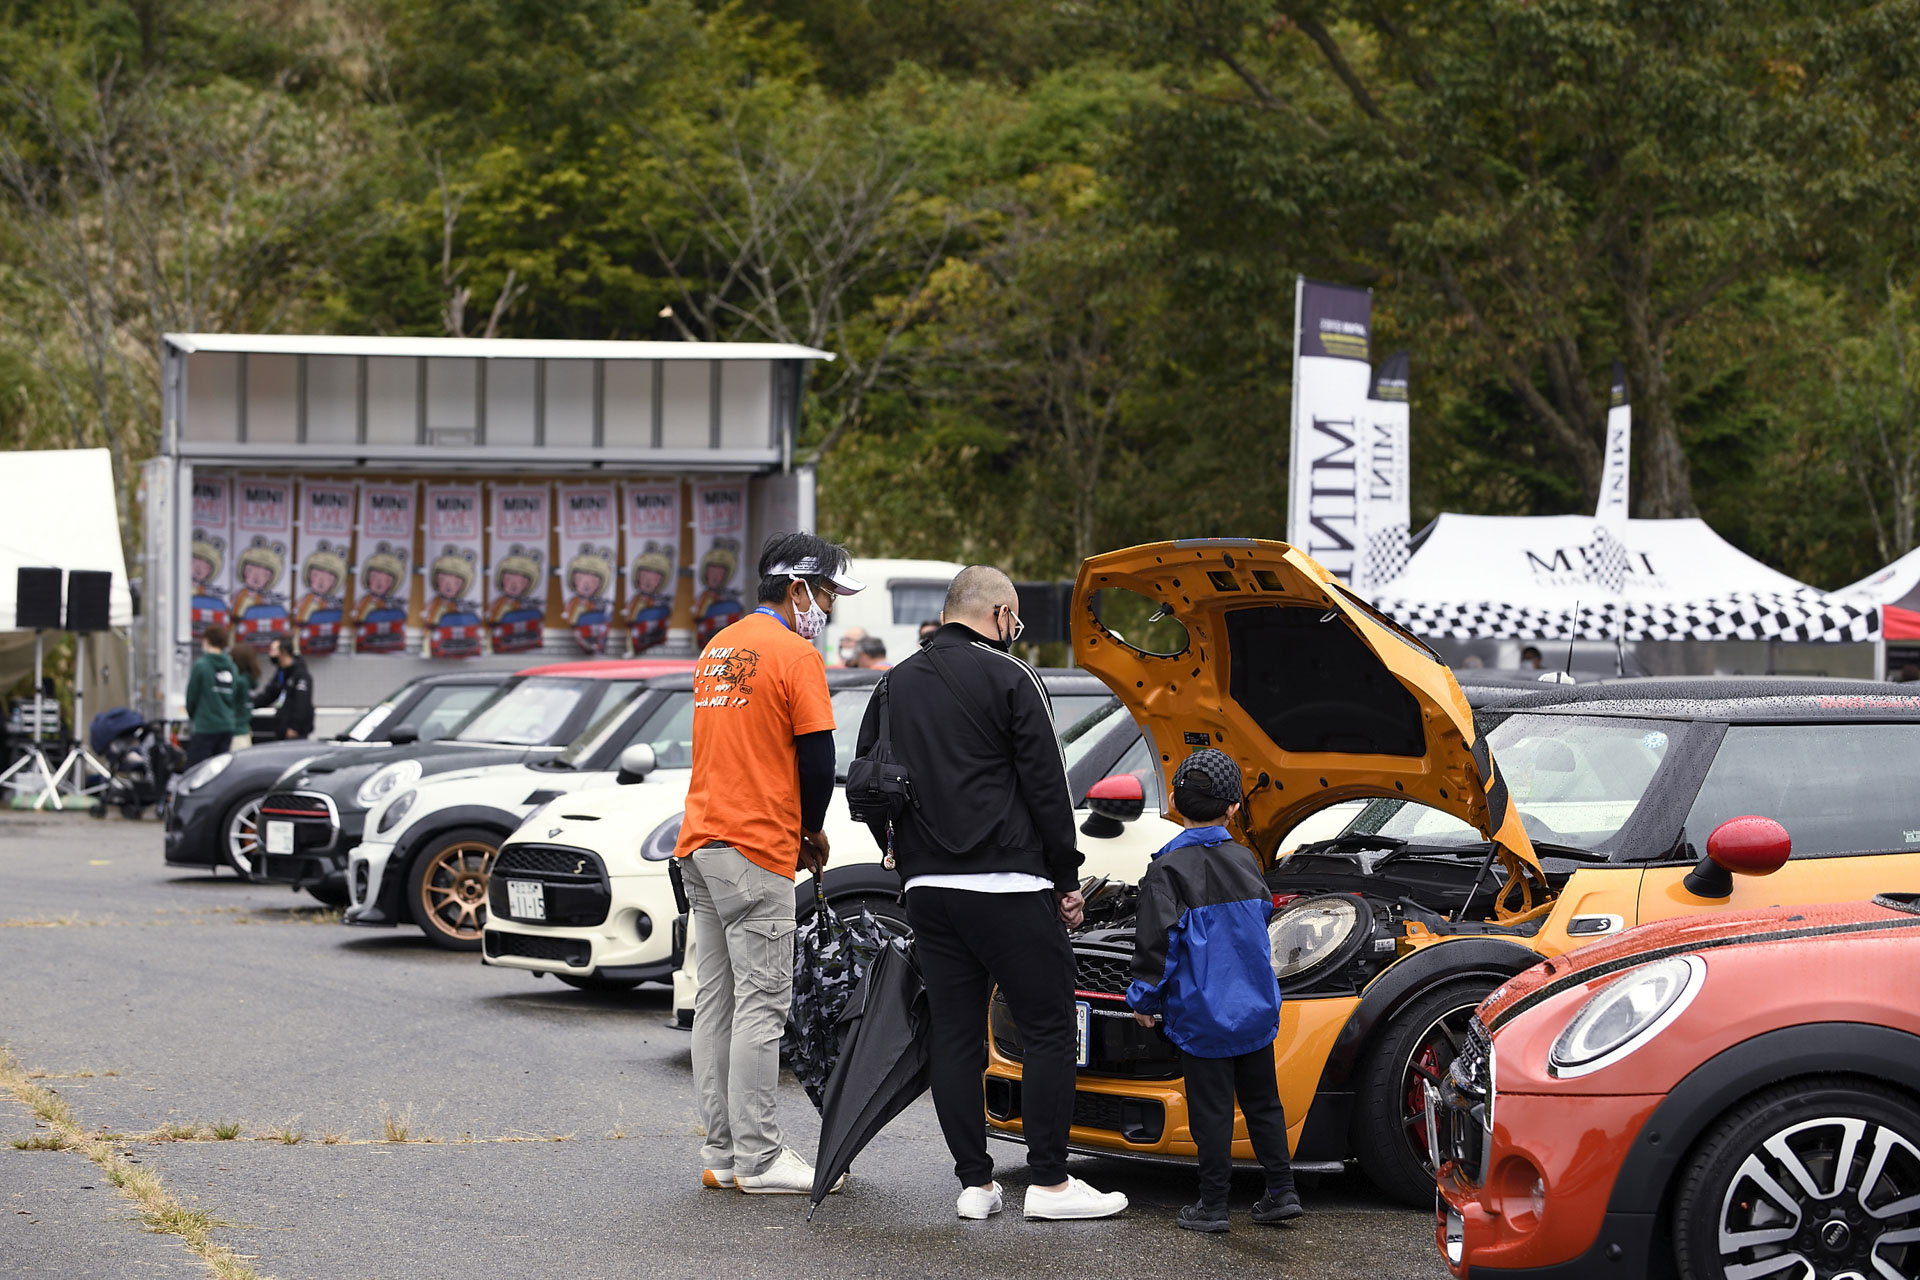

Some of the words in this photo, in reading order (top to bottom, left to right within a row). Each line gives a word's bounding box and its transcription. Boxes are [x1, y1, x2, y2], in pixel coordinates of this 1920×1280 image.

[1609, 429, 1625, 505] MINI
[246, 488, 283, 504] MINI
[312, 493, 349, 508] MINI
[371, 495, 408, 510] MINI
[570, 496, 607, 511] MINI
[635, 493, 673, 509] MINI
[703, 490, 740, 507] MINI
[436, 497, 474, 512] MINI
[503, 497, 540, 512] MINI
[707, 647, 735, 659] MINI
[703, 664, 728, 677] LIFE
[574, 861, 586, 874] S
[1597, 919, 1607, 930] S
[1826, 1225, 1845, 1246] MINI
